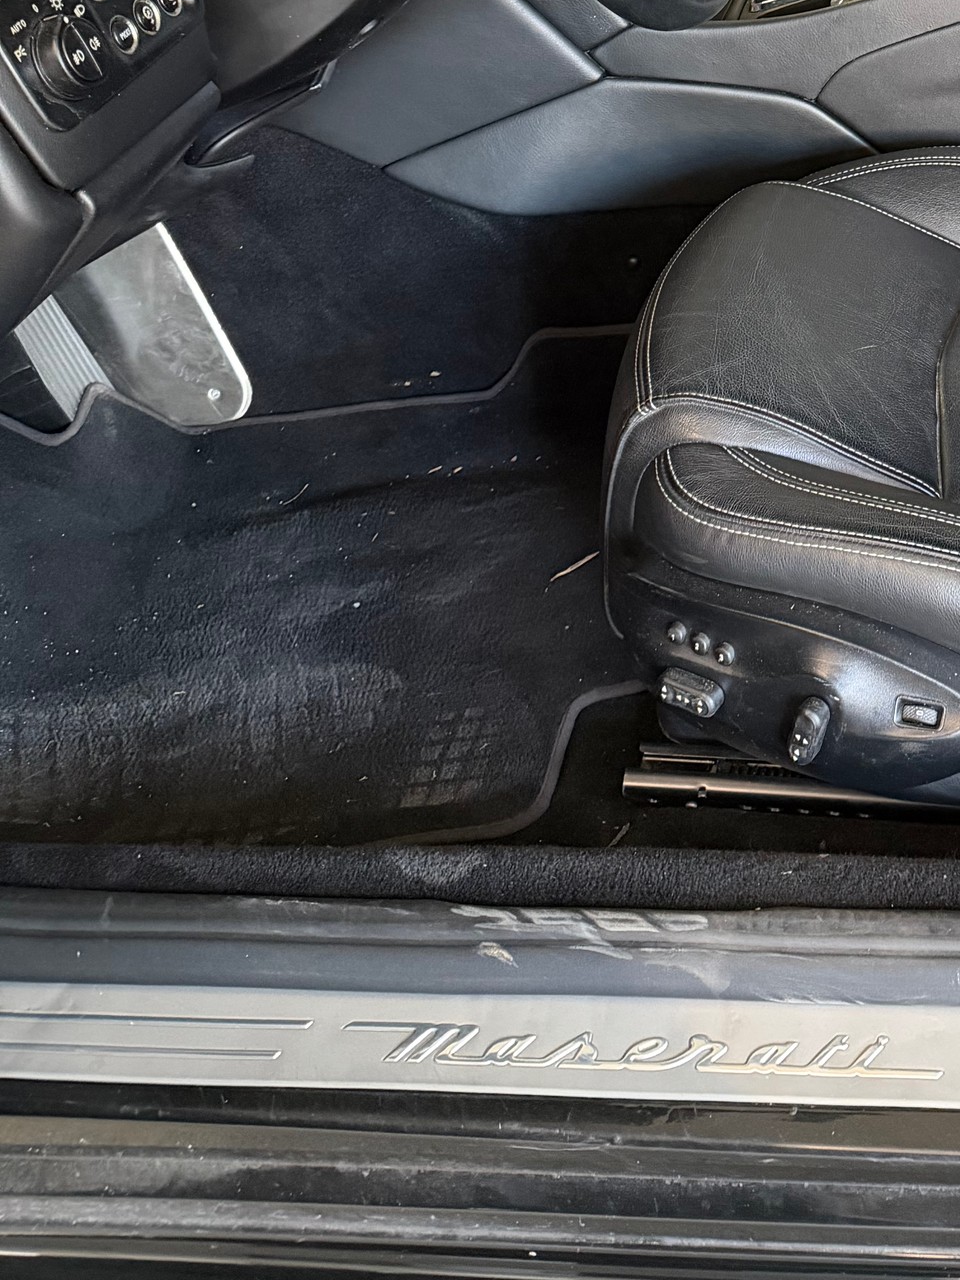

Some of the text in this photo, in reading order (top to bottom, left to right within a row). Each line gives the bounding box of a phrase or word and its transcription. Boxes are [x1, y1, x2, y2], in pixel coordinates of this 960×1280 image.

[10, 19, 27, 36] AUTO
[694, 642, 700, 651] 2
[717, 653, 724, 663] 3
[341, 1020, 944, 1080] Maserati
